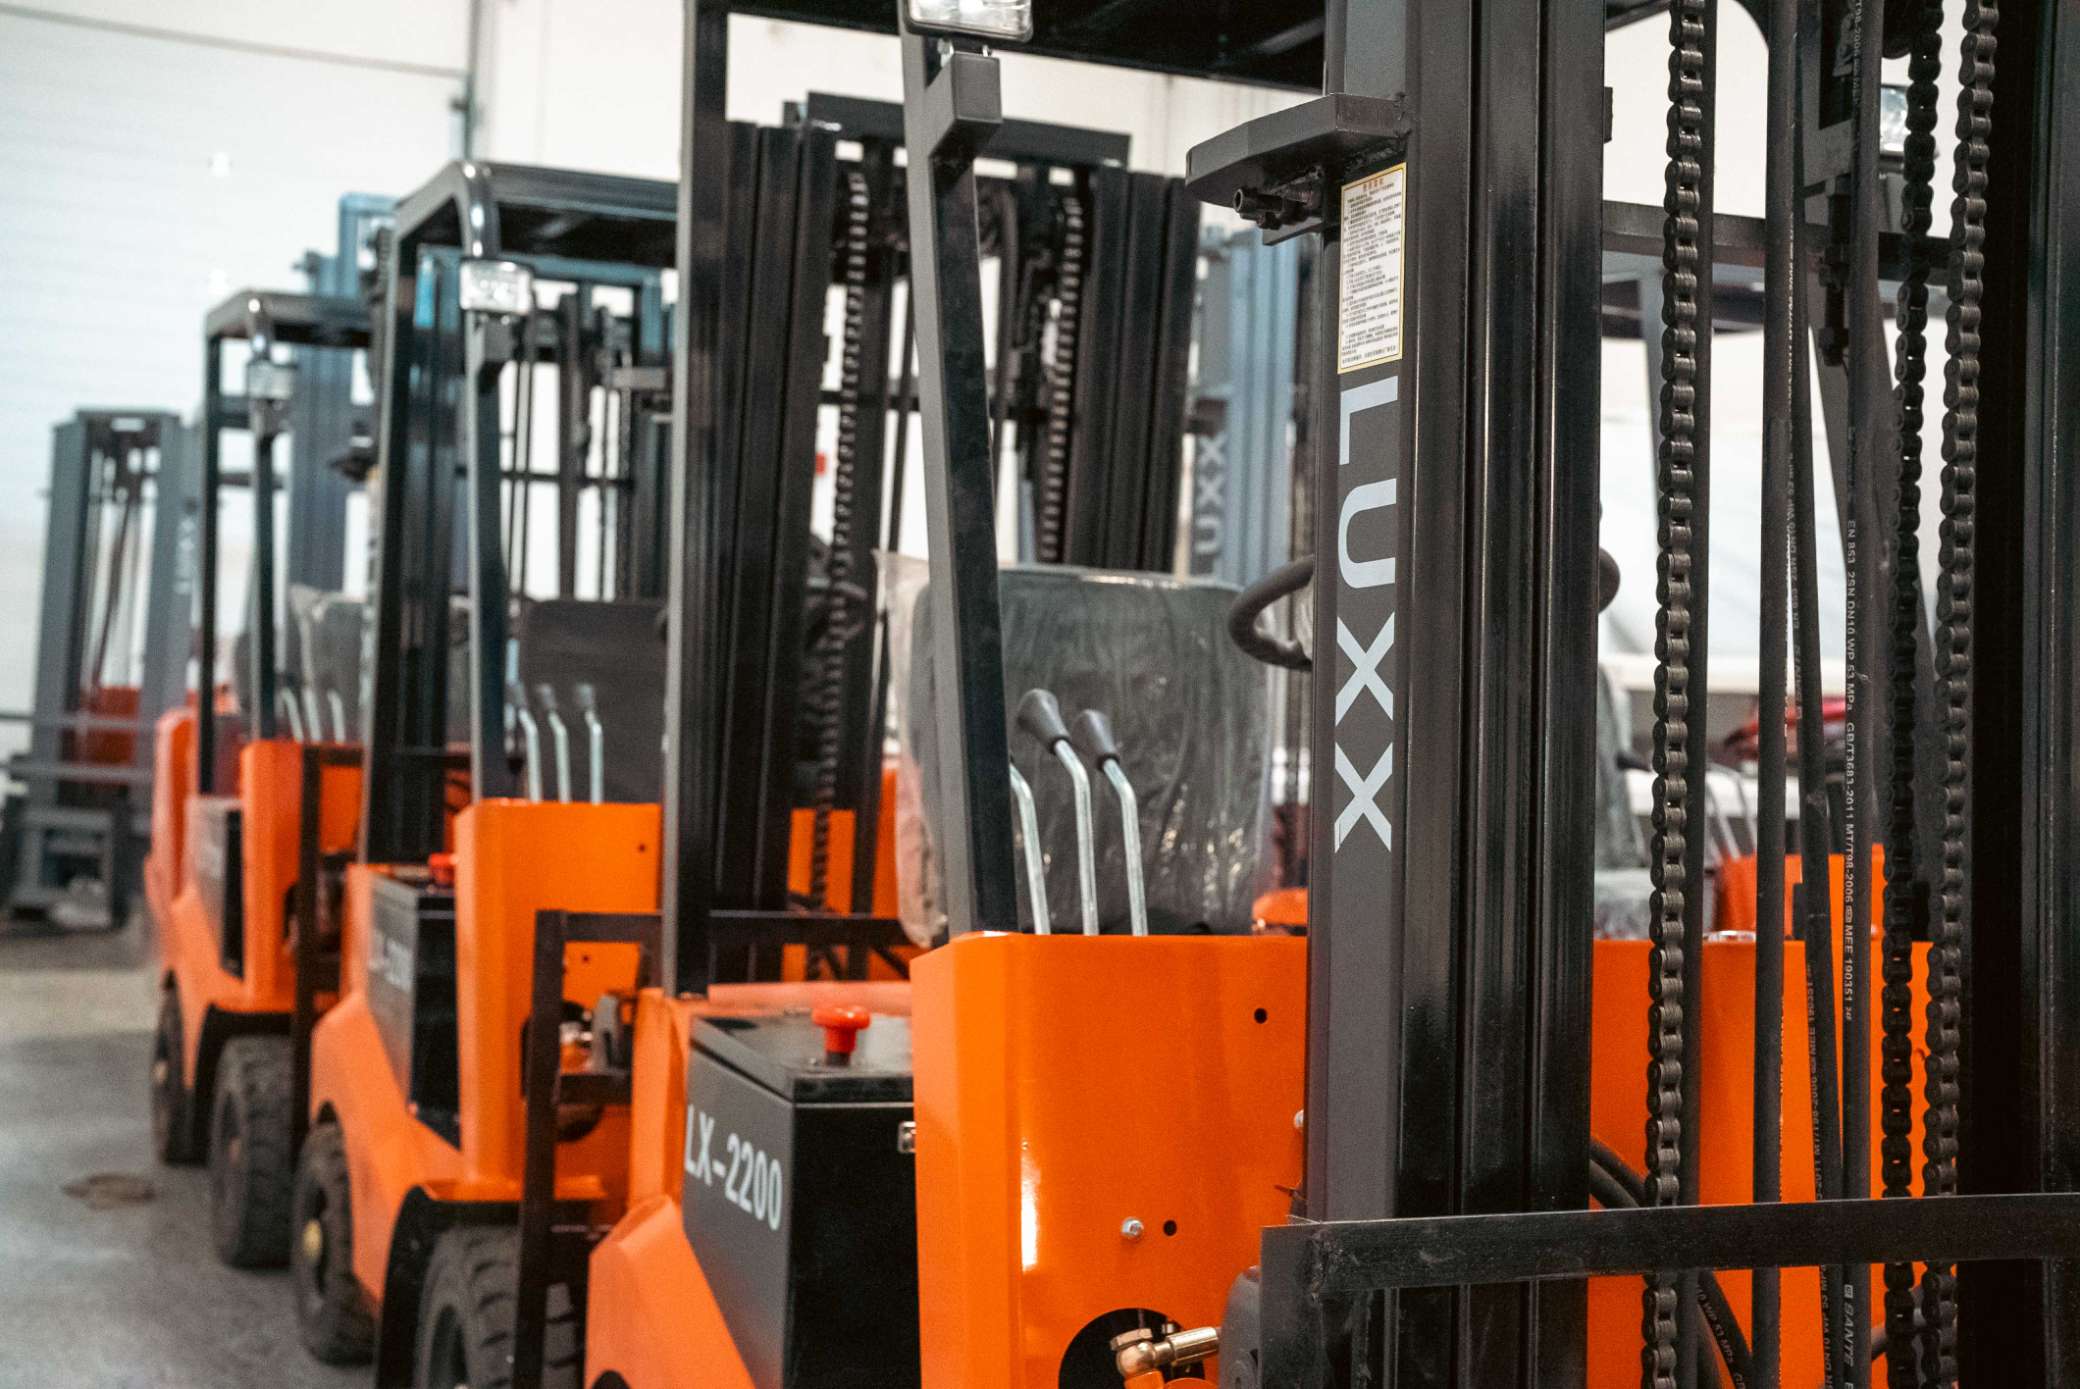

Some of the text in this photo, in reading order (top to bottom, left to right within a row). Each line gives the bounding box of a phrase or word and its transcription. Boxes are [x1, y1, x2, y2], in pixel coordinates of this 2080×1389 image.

[1847, 519, 1857, 538] EN
[1846, 542, 1856, 564] 853
[1846, 571, 1856, 596] 2SN
[1334, 375, 1398, 854] LUXX
[1846, 600, 1856, 634] DN10
[1846, 638, 1856, 661] WP
[1846, 663, 1855, 680] 53
[1846, 683, 1855, 711] MPa
[1845, 722, 1855, 819] GB/T3683-2011
[1844, 823, 1854, 904] MT/T98-2006
[684, 1103, 783, 1231] LX-2200
